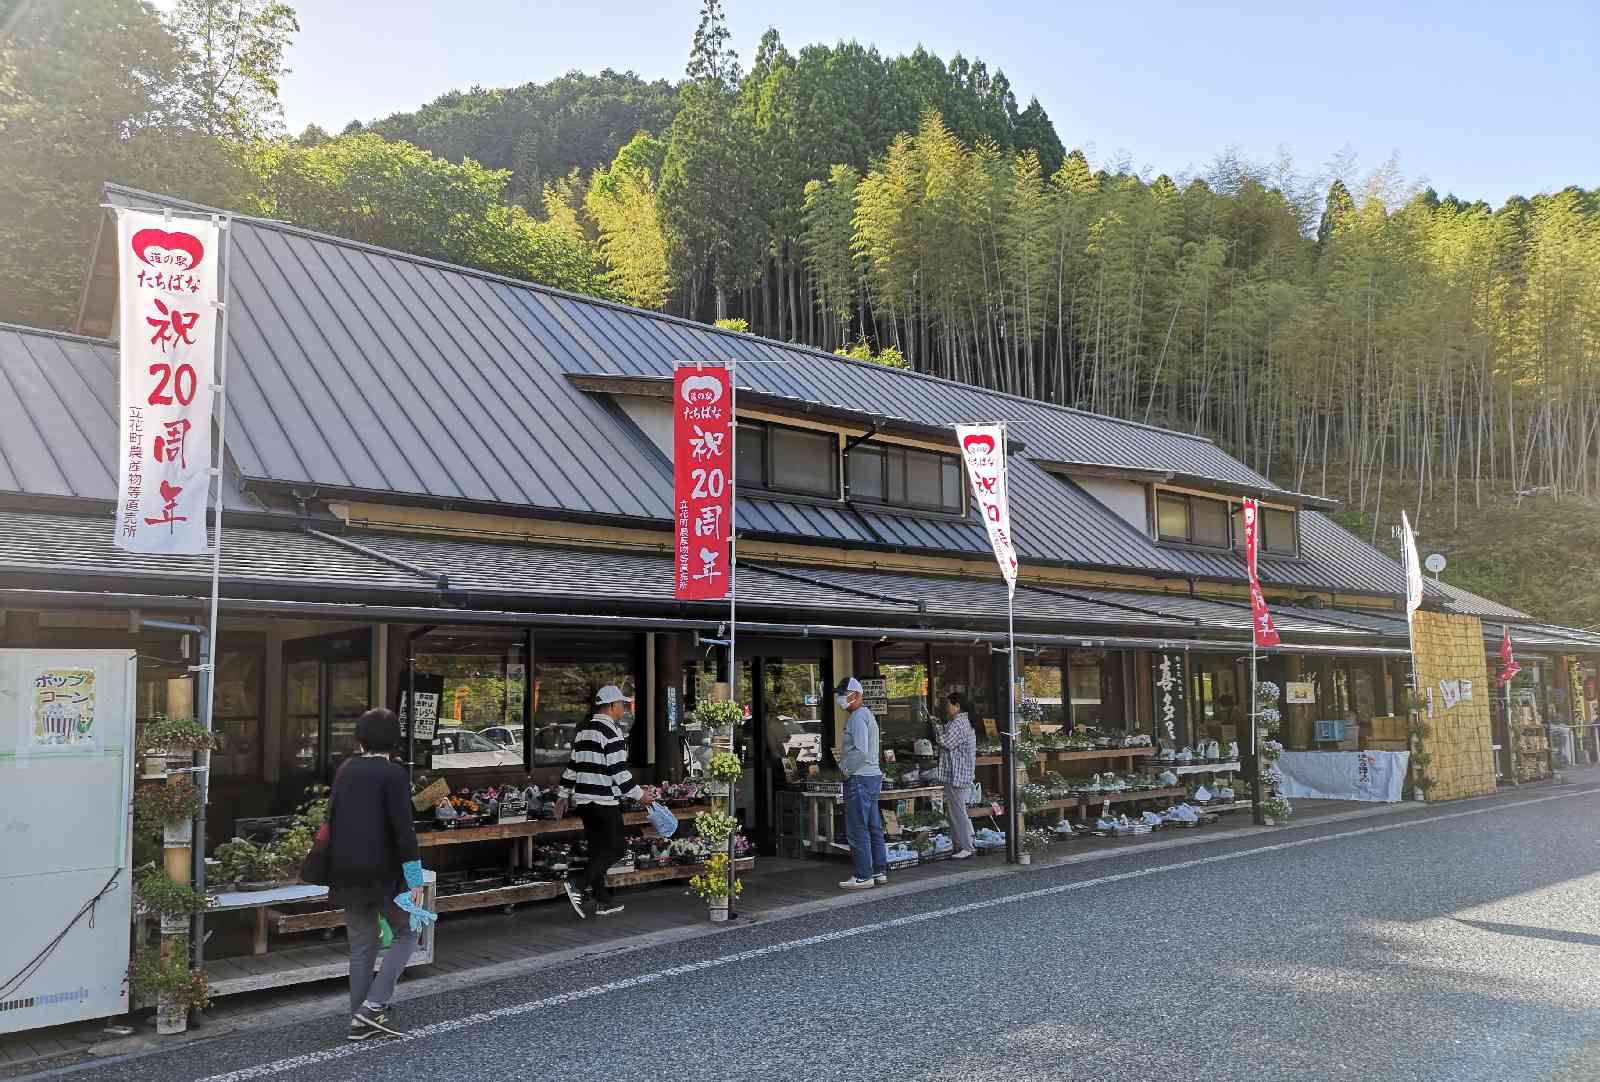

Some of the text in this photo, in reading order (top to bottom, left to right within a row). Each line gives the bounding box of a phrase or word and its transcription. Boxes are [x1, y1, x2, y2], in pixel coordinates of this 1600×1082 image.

[137, 269, 201, 294] たちばな
[34, 672, 88, 688] ポップ
[39, 690, 89, 704] コーン
